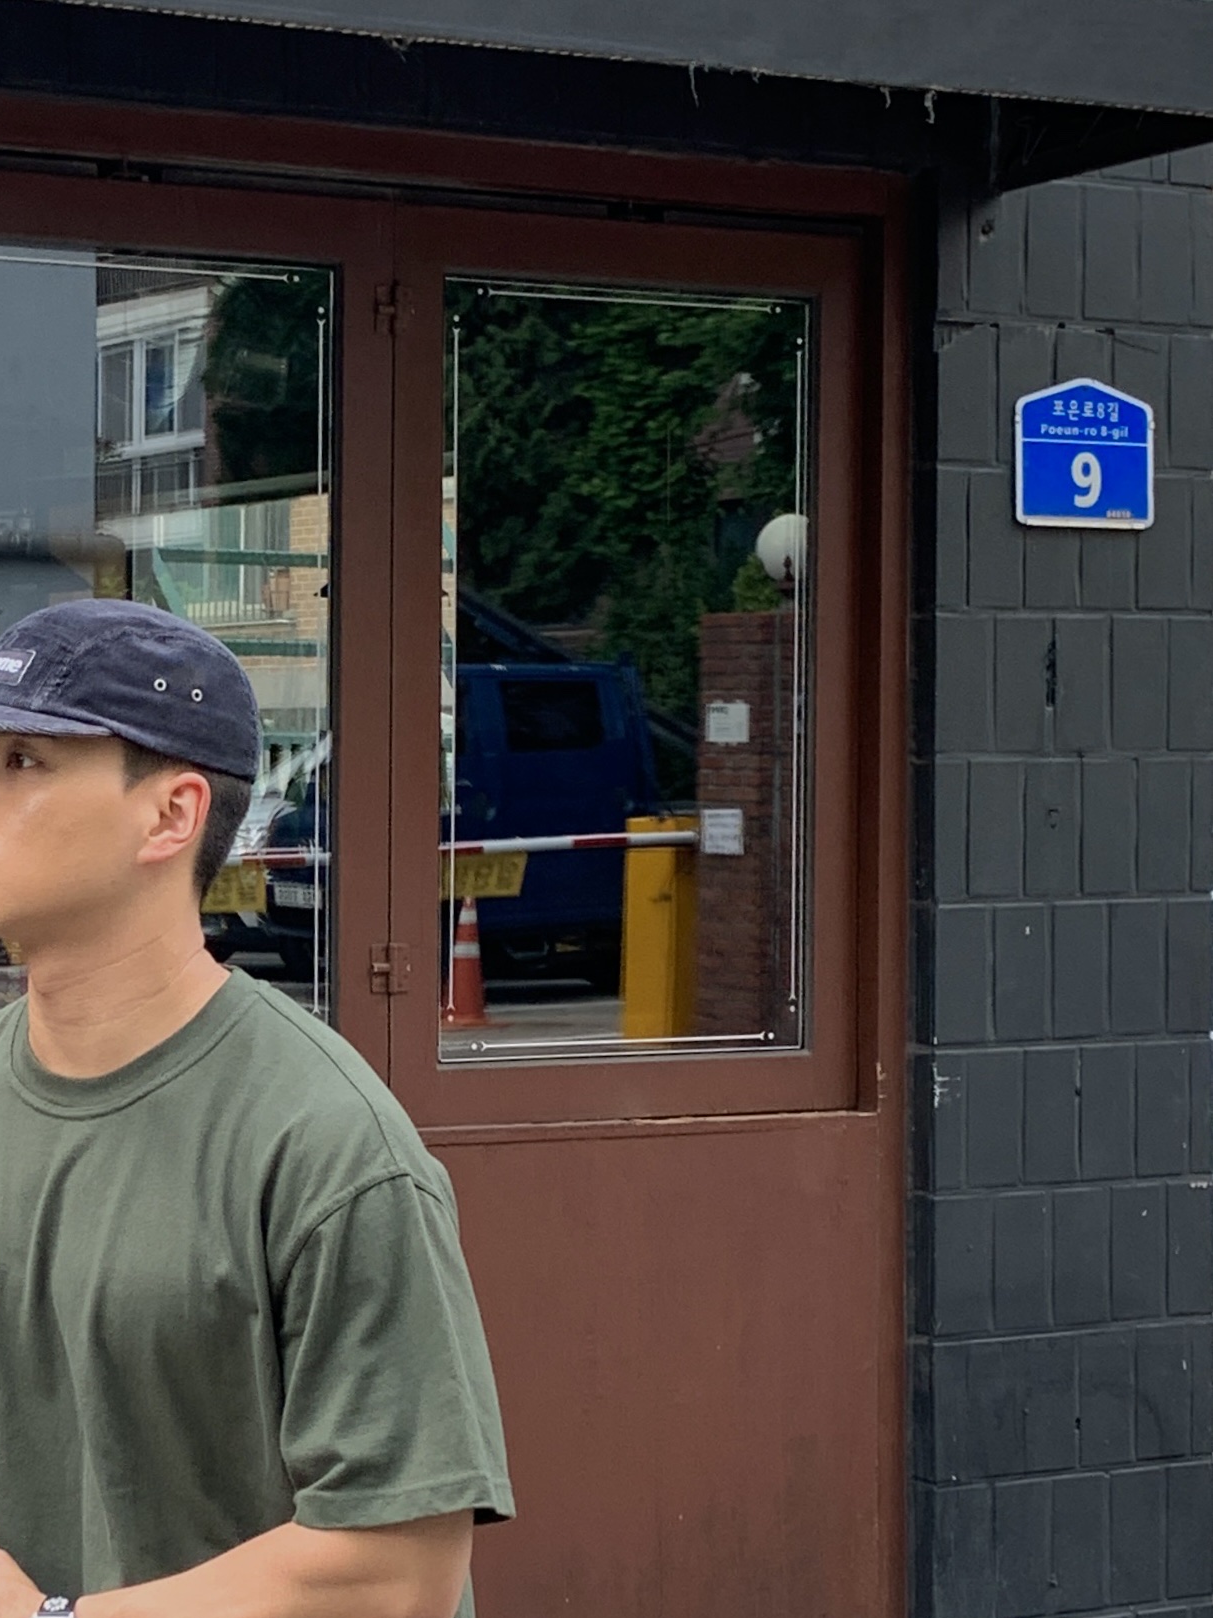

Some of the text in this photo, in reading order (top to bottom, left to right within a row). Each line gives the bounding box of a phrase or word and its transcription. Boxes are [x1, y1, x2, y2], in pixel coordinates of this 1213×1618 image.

[1052, 399, 1119, 422] 포은로8길
[1040, 424, 1129, 440] Poeun-ro 8-gil
[1071, 451, 1102, 508] 9
